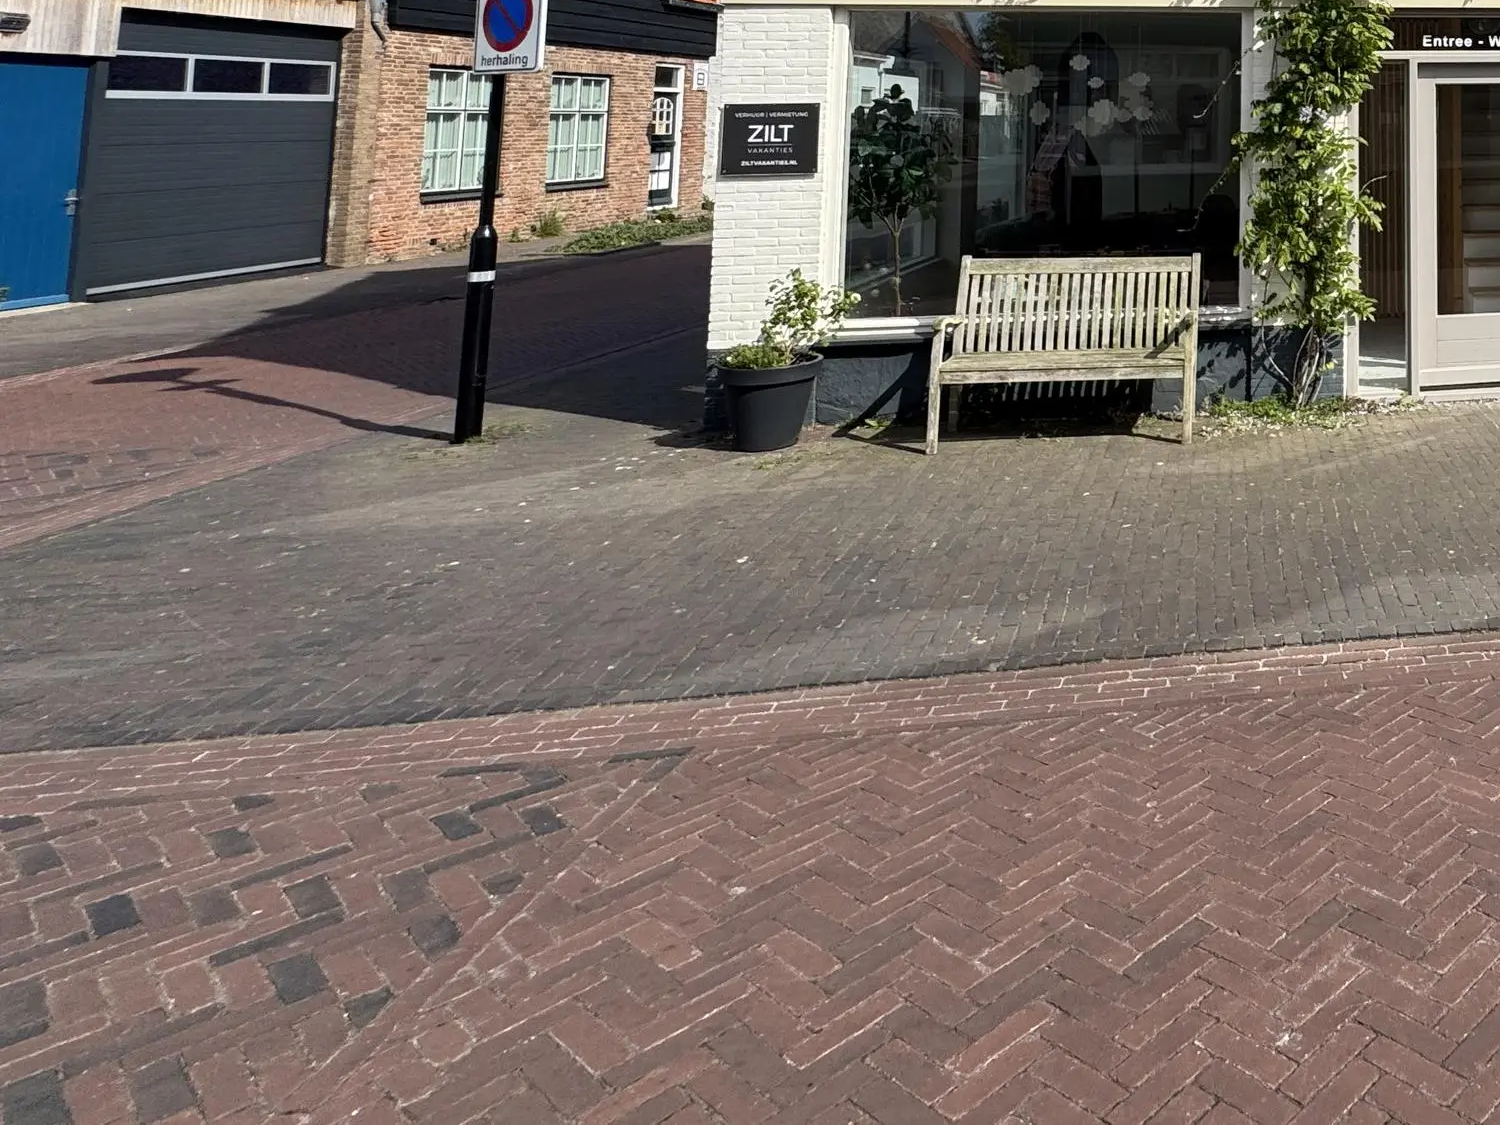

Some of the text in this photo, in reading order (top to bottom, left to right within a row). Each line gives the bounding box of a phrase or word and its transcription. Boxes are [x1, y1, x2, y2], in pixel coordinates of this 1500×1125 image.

[1422, 34, 1473, 47] Entree
[480, 53, 529, 67] herhaling
[747, 124, 795, 143] ZILT
[747, 146, 793, 154] VAKANTIES
